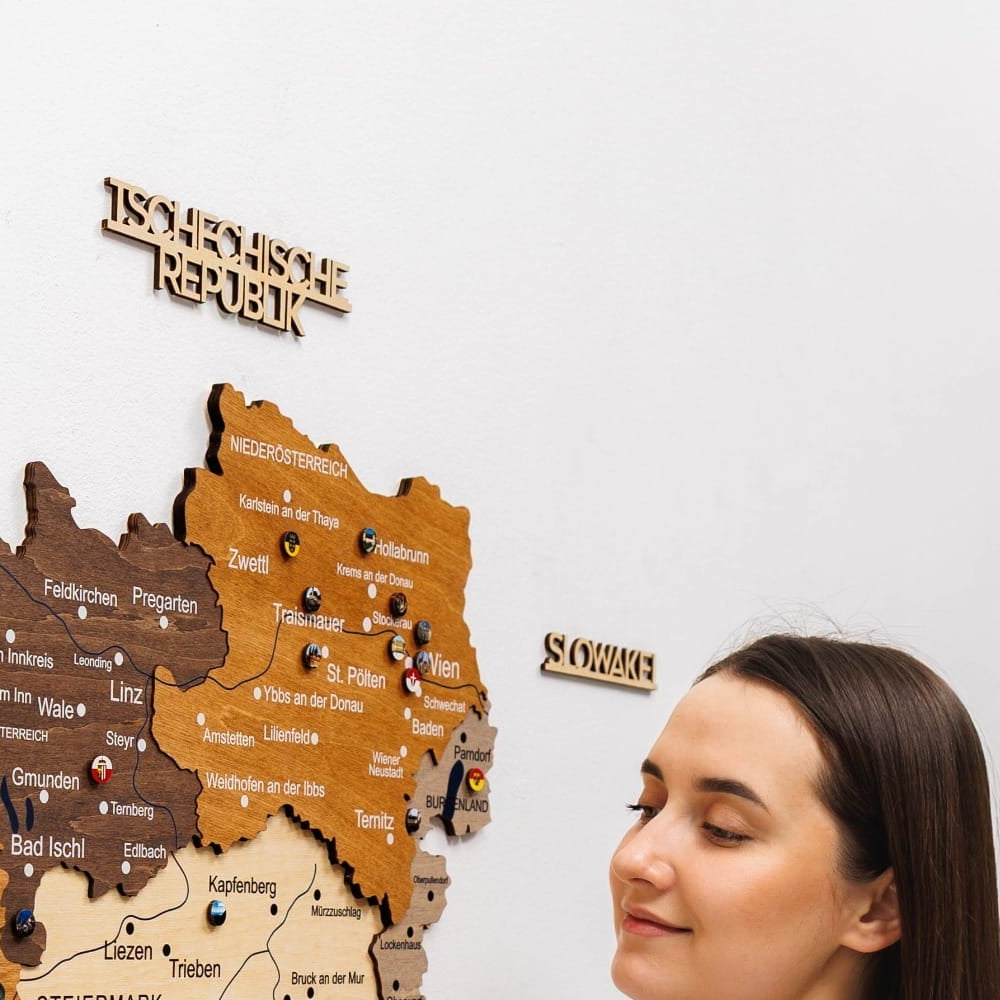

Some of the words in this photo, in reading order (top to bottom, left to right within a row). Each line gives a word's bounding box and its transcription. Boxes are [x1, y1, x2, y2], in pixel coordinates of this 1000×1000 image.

[103, 177, 351, 308] TSCHECHISCHE
[153, 244, 306, 337] REPUBLIK
[230, 435, 348, 479] NIEDERÖSTERREICH
[239, 493, 280, 515] Karlstein
[281, 505, 294, 518] an
[296, 507, 310, 523] der
[313, 511, 340, 530] Thaya
[228, 548, 270, 575] Zwettl
[374, 539, 430, 566] Hollabrunn
[336, 563, 362, 580] Krems
[363, 569, 374, 581] an
[375, 568, 388, 584] der
[389, 573, 414, 589] Donau
[44, 578, 118, 607] Feldkirchen
[132, 586, 198, 615] Pregarten
[273, 602, 345, 633] Traismauer
[372, 610, 413, 630] Stockerau
[8, 647, 54, 669] Innkreis
[73, 653, 113, 672] Leonding
[327, 663, 344, 684] St.
[348, 664, 386, 690] Pölten
[14, 687, 32, 705] Inn
[110, 679, 144, 705] Linz
[263, 685, 291, 706] Ybbs
[293, 691, 307, 706] an
[309, 689, 328, 708] der
[330, 693, 364, 713] Donau
[38, 697, 75, 720] Wale
[424, 696, 466, 713] Schwechat
[203, 726, 255, 748] Amstetten
[263, 725, 310, 745] Lilienfeld
[412, 718, 444, 737] Baden
[106, 730, 135, 751] Steyr
[372, 751, 401, 766] Wiener
[454, 745, 492, 763] Parndorf
[11, 766, 80, 791] Gmunden
[368, 763, 404, 779] Neustadt
[206, 772, 264, 793] Weidhofen
[267, 779, 281, 794] an
[283, 777, 301, 796] der
[303, 780, 326, 798] Ibbs
[110, 801, 154, 821] Ternberg
[426, 794, 489, 813] BURENLAND
[354, 809, 395, 831] Ternitz
[11, 833, 43, 858] Bad
[49, 836, 85, 859] Ischl
[124, 842, 167, 860] Edlbach
[208, 875, 277, 899] Kapfenberg
[311, 905, 362, 920] Mürzzuschlag
[104, 940, 153, 961] Liezen
[380, 939, 421, 951] Lockenhaus
[169, 958, 221, 979] Trieben
[291, 971, 317, 986] Bruck
[319, 974, 331, 986] an
[332, 971, 346, 985] der
[348, 971, 365, 985] Mur
